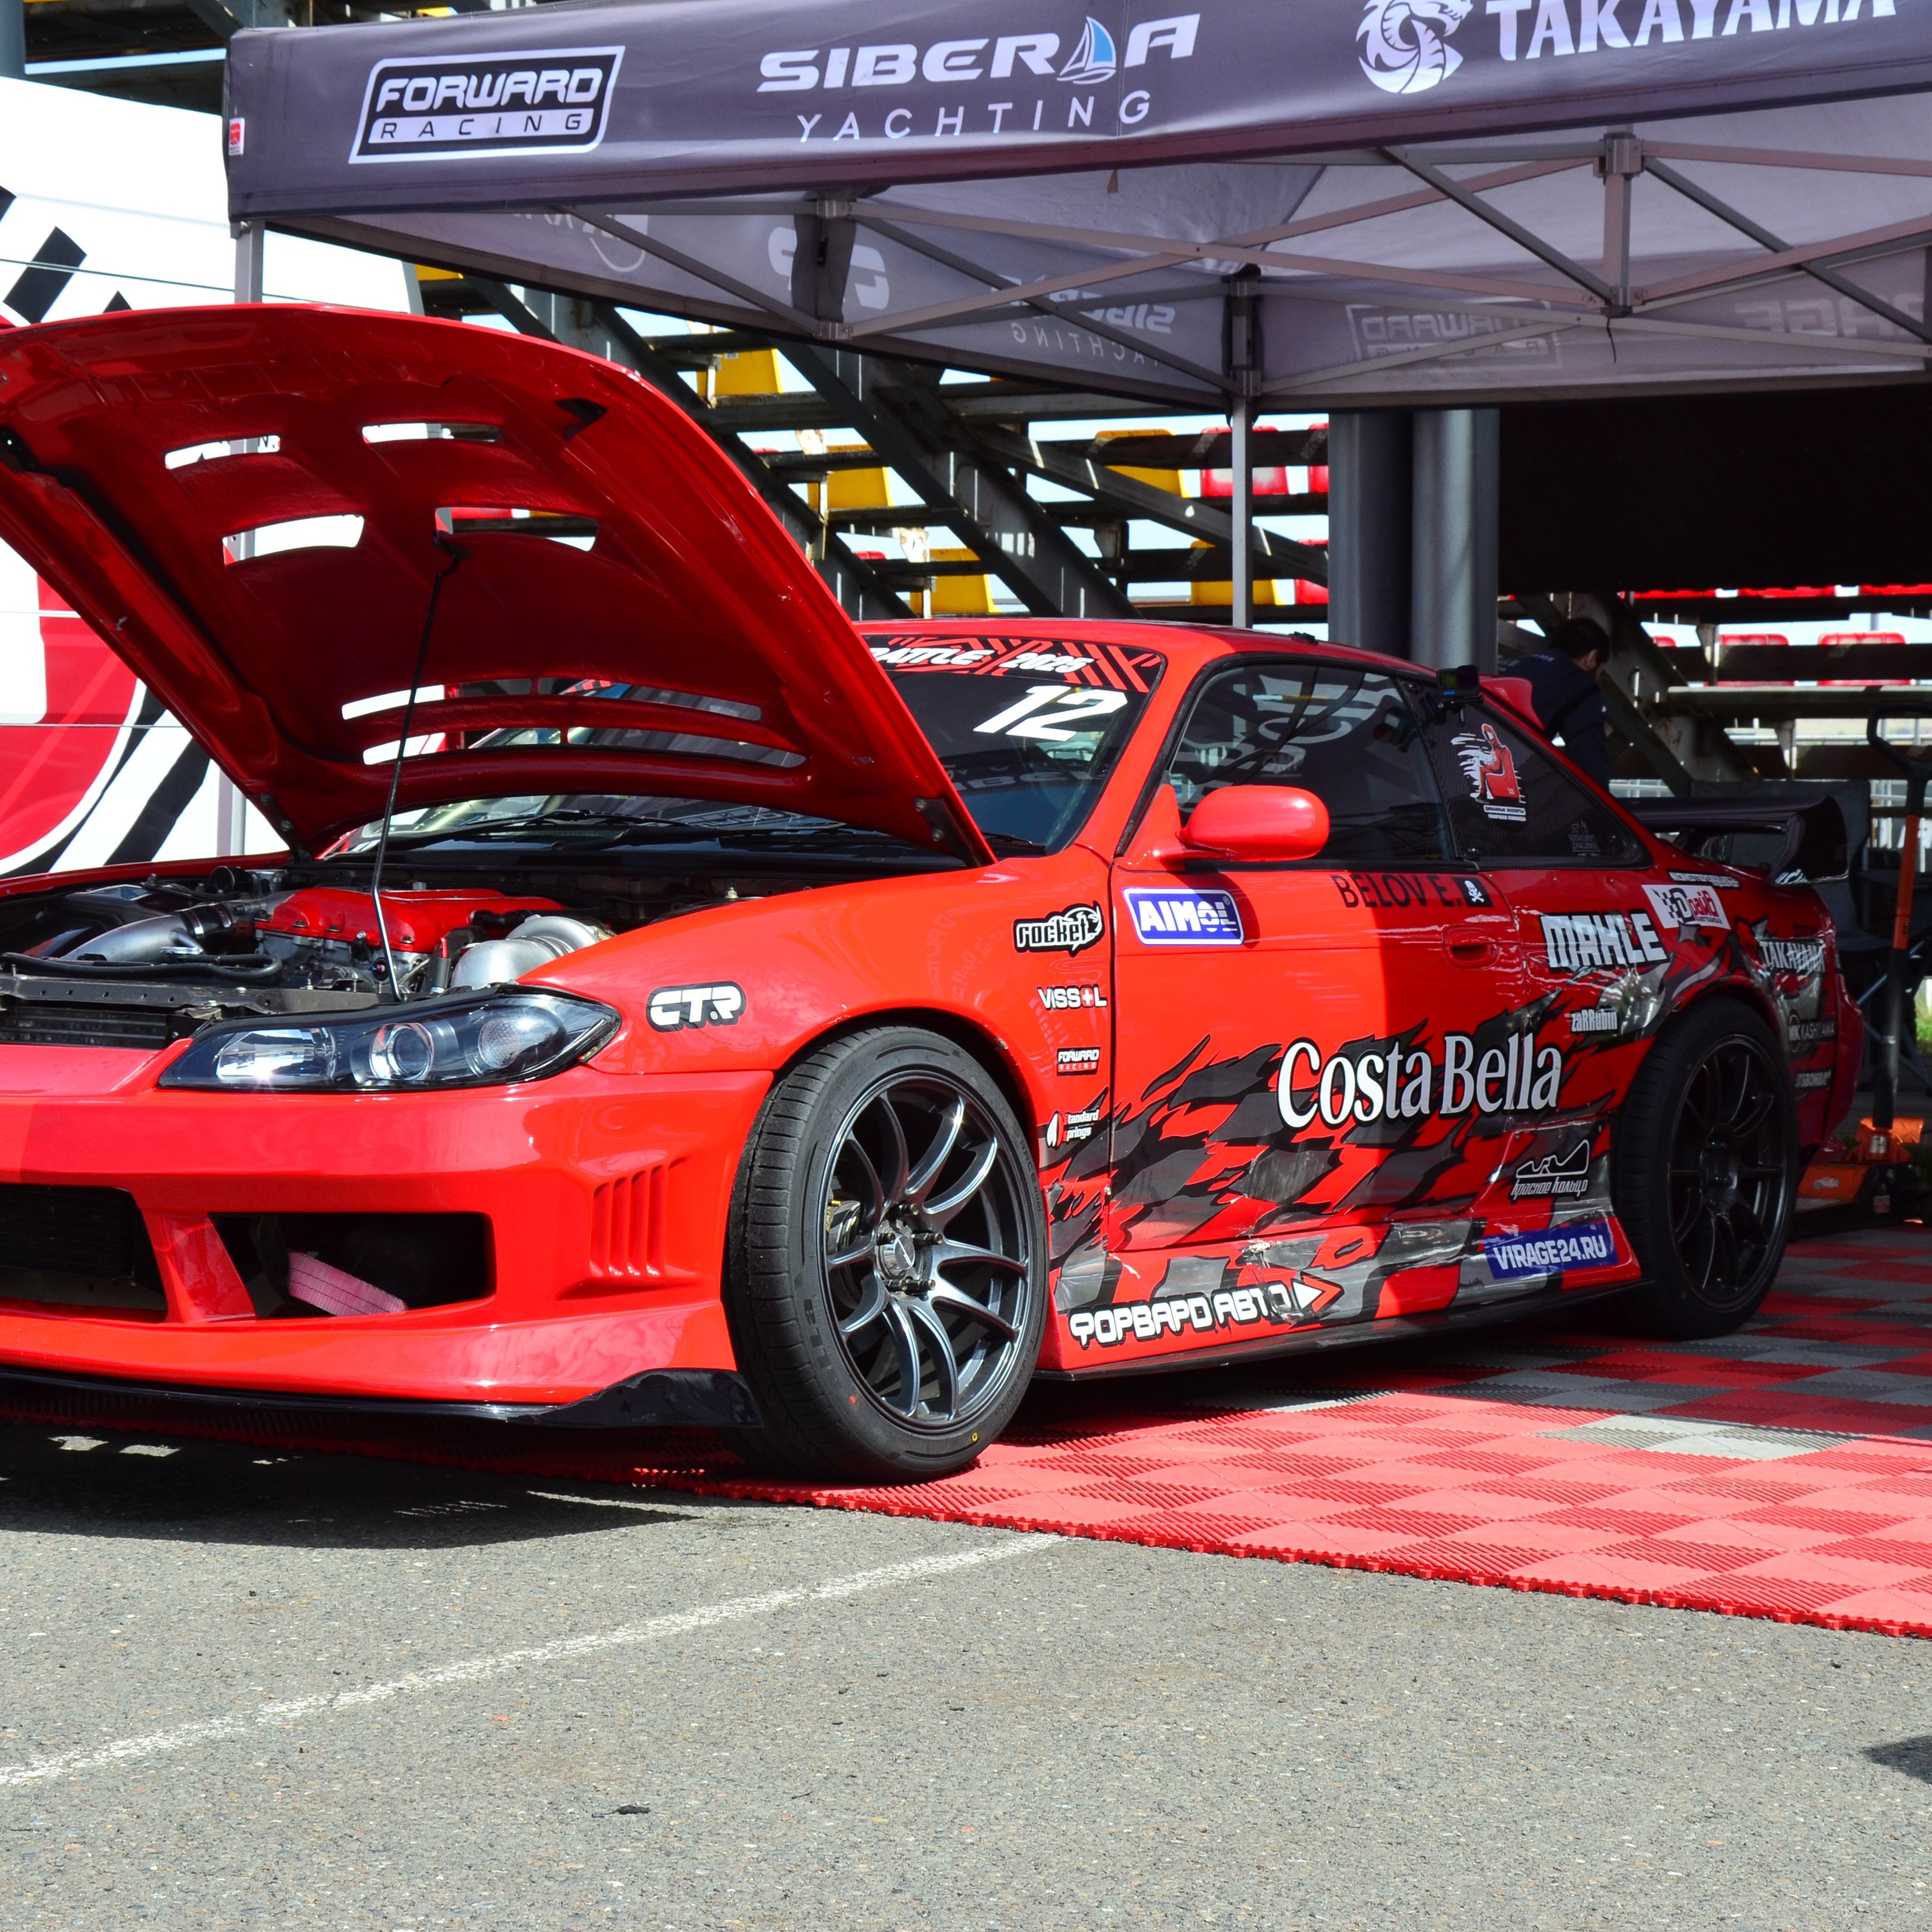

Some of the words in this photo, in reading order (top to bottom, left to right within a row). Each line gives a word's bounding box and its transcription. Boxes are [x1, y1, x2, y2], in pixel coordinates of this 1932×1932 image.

[376, 68, 603, 112] FORWARD
[380, 112, 583, 139] RACING
[796, 90, 1150, 143] YACHTING
[998, 652, 1094, 673] 2025
[972, 685, 1128, 742] 12
[1330, 872, 1427, 909] BELOV
[1017, 915, 1088, 947] rocket
[1140, 900, 1238, 933] AIMOL
[1540, 912, 1668, 968] MAHLE
[650, 986, 742, 1026] CTR
[1057, 1049, 1100, 1063] FORWARD
[1059, 1063, 1097, 1071] RACING
[1277, 1041, 1432, 1128] Costa
[1439, 1032, 1562, 1115] Bella
[1492, 1235, 1607, 1271] VIRAGE24.RU
